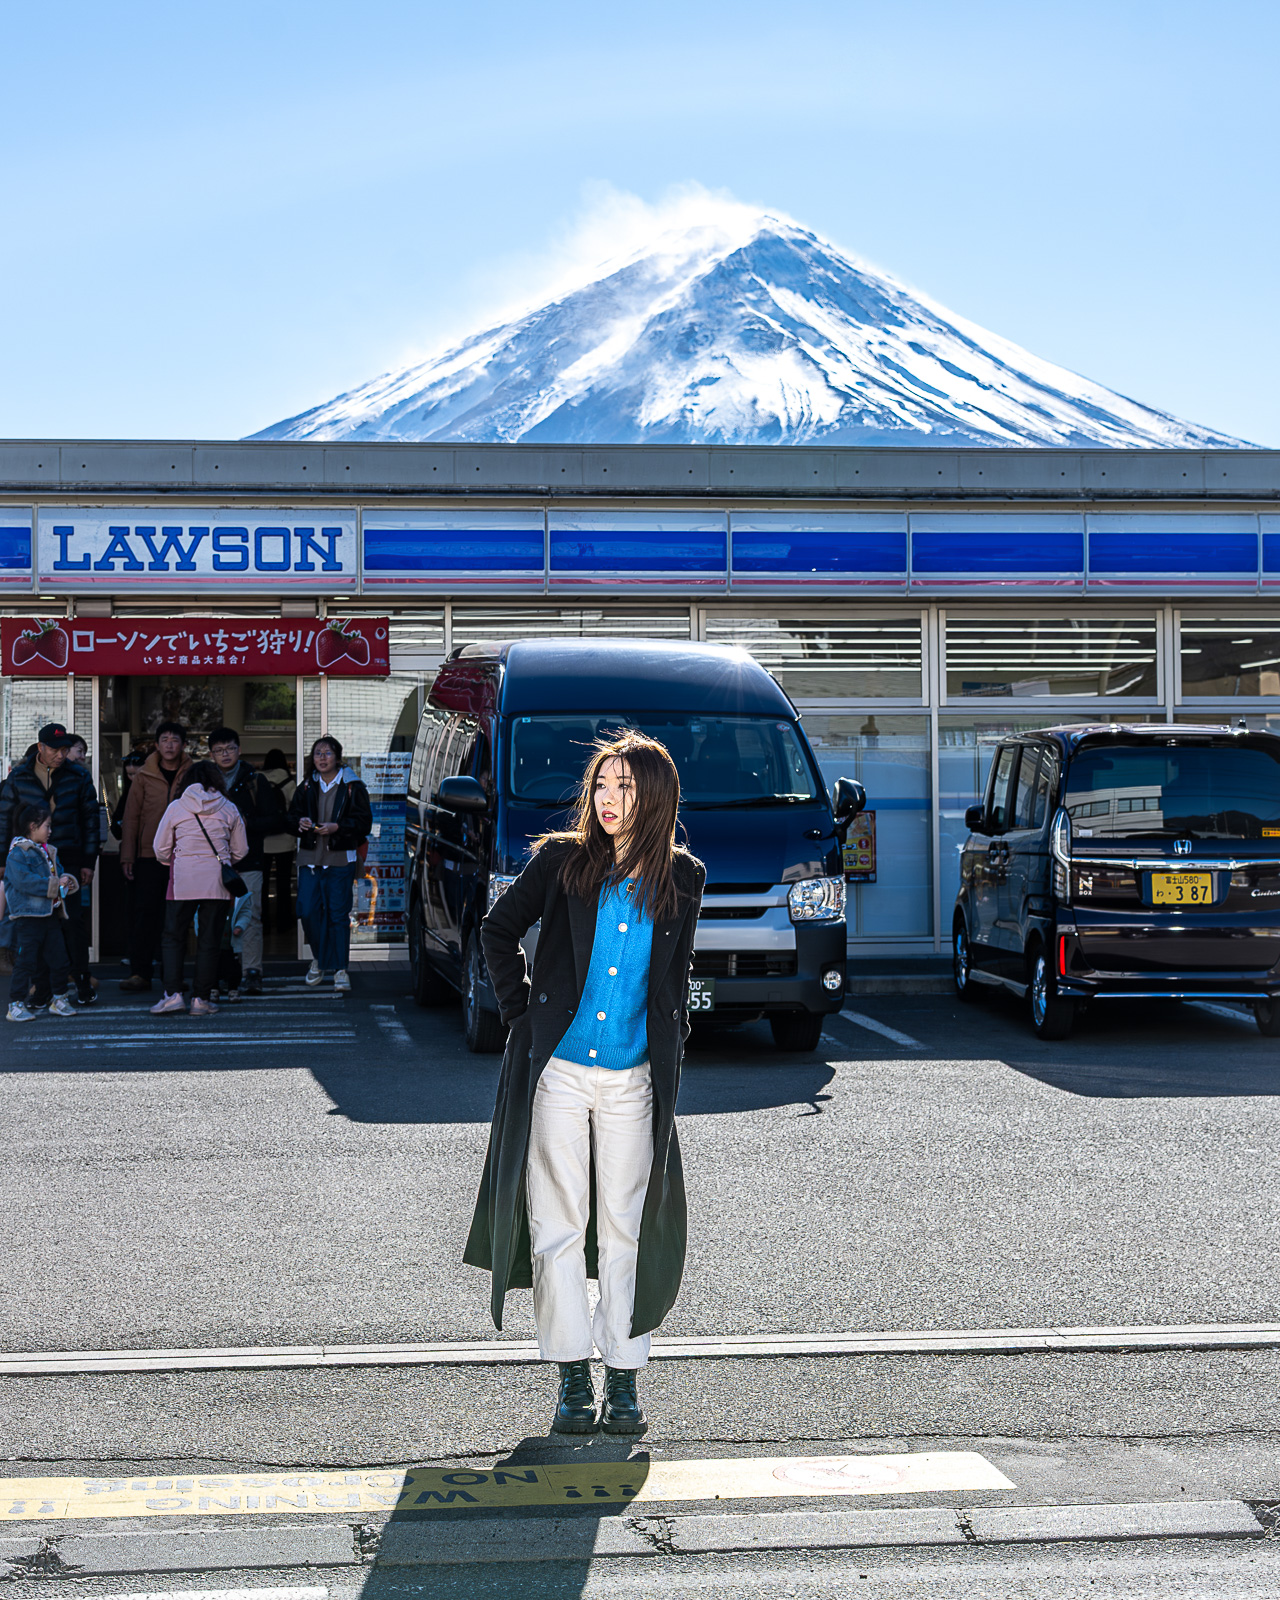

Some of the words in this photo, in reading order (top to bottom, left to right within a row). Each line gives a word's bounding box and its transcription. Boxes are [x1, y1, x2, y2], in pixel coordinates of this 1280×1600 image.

[53, 526, 343, 571] LAWSON
[72, 629, 315, 655] ローソンでいちご狩り!
[143, 655, 246, 665] いちご商品大集合!
[369, 867, 401, 878] ATM
[1165, 876, 1199, 885] 富士山580
[441, 1470, 539, 1486] NO
[145, 1490, 480, 1511] WARNING
